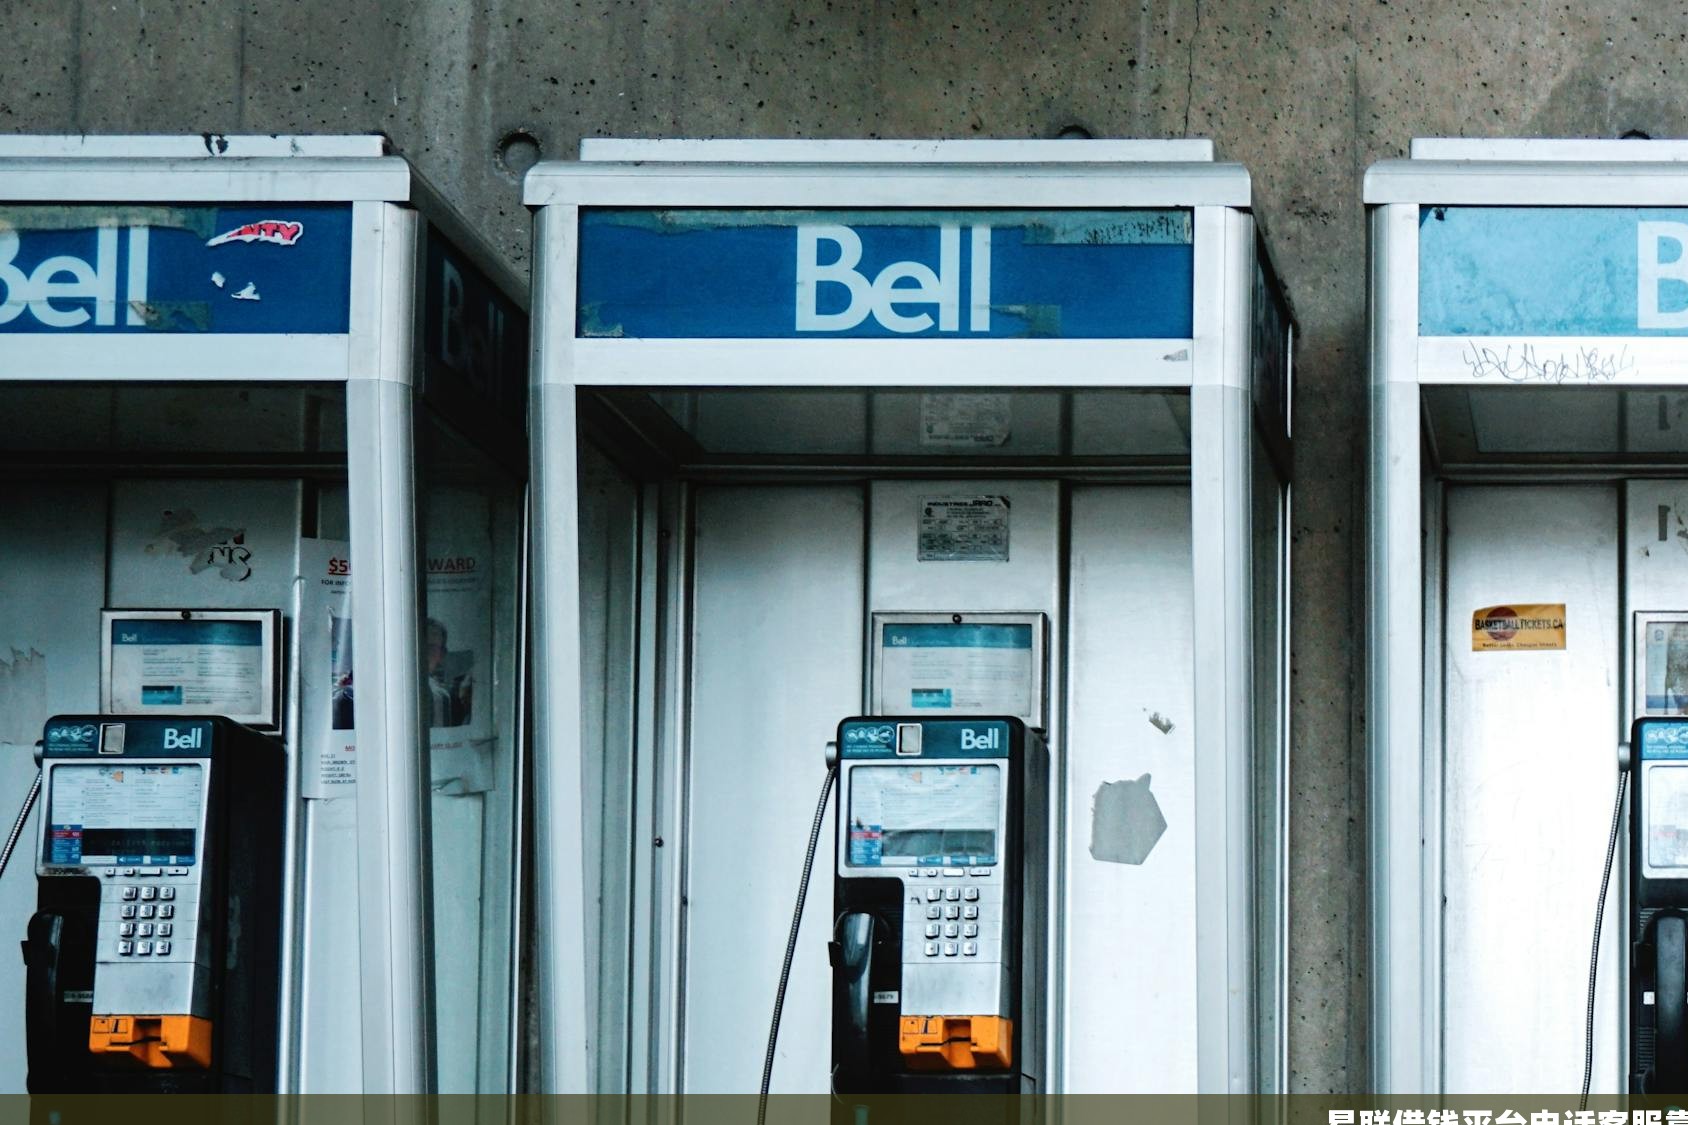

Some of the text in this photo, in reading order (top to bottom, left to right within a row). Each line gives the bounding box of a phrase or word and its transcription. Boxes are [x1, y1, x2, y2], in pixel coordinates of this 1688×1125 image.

[795, 224, 991, 331] Bell
[328, 557, 351, 573] $5
[122, 633, 138, 642] Bell
[892, 636, 907, 645] Bell
[163, 728, 202, 749] Bell
[961, 727, 999, 749] Bell
